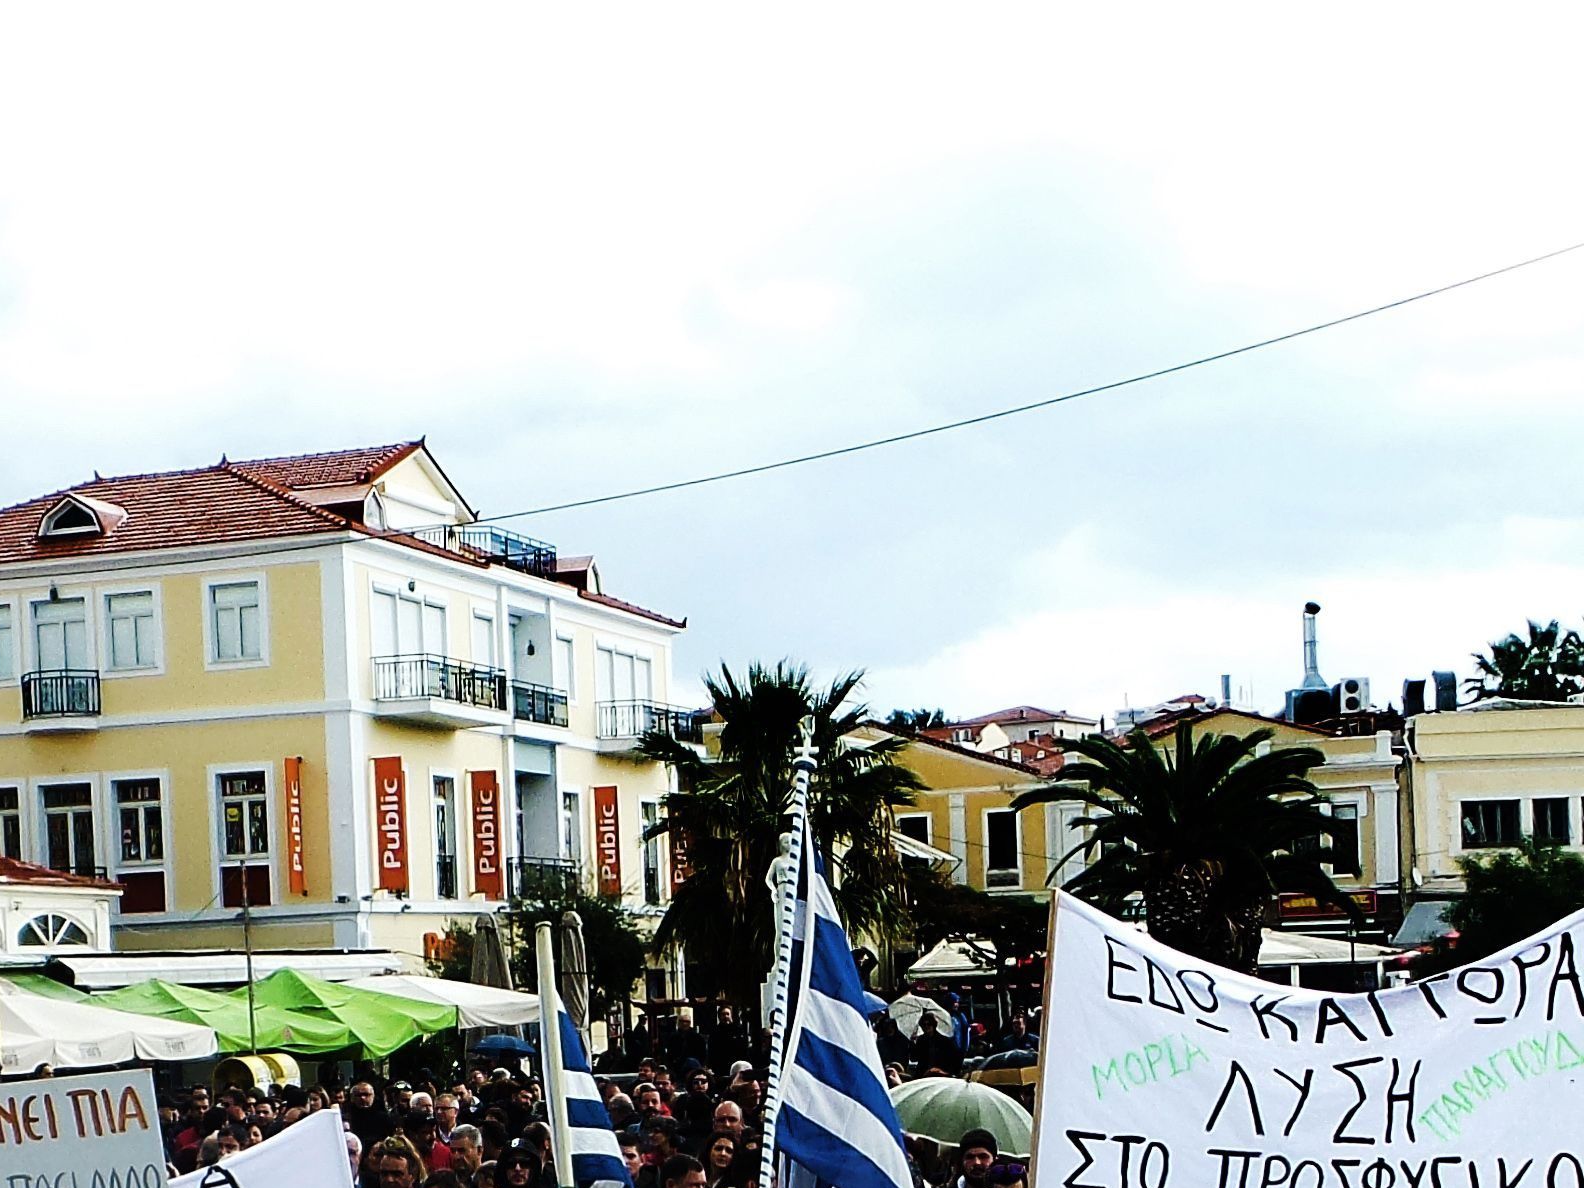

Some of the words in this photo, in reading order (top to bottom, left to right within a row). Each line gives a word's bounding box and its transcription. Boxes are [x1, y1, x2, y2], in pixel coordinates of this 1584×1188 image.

[380, 777, 401, 868] Public
[476, 789, 496, 874] Public
[599, 803, 618, 881] Public
[1250, 990, 1394, 1044] ΚΑΙ
[66, 1086, 149, 1138] ΠΙΑ
[1206, 1056, 1422, 1144] ΛΥΣΗ
